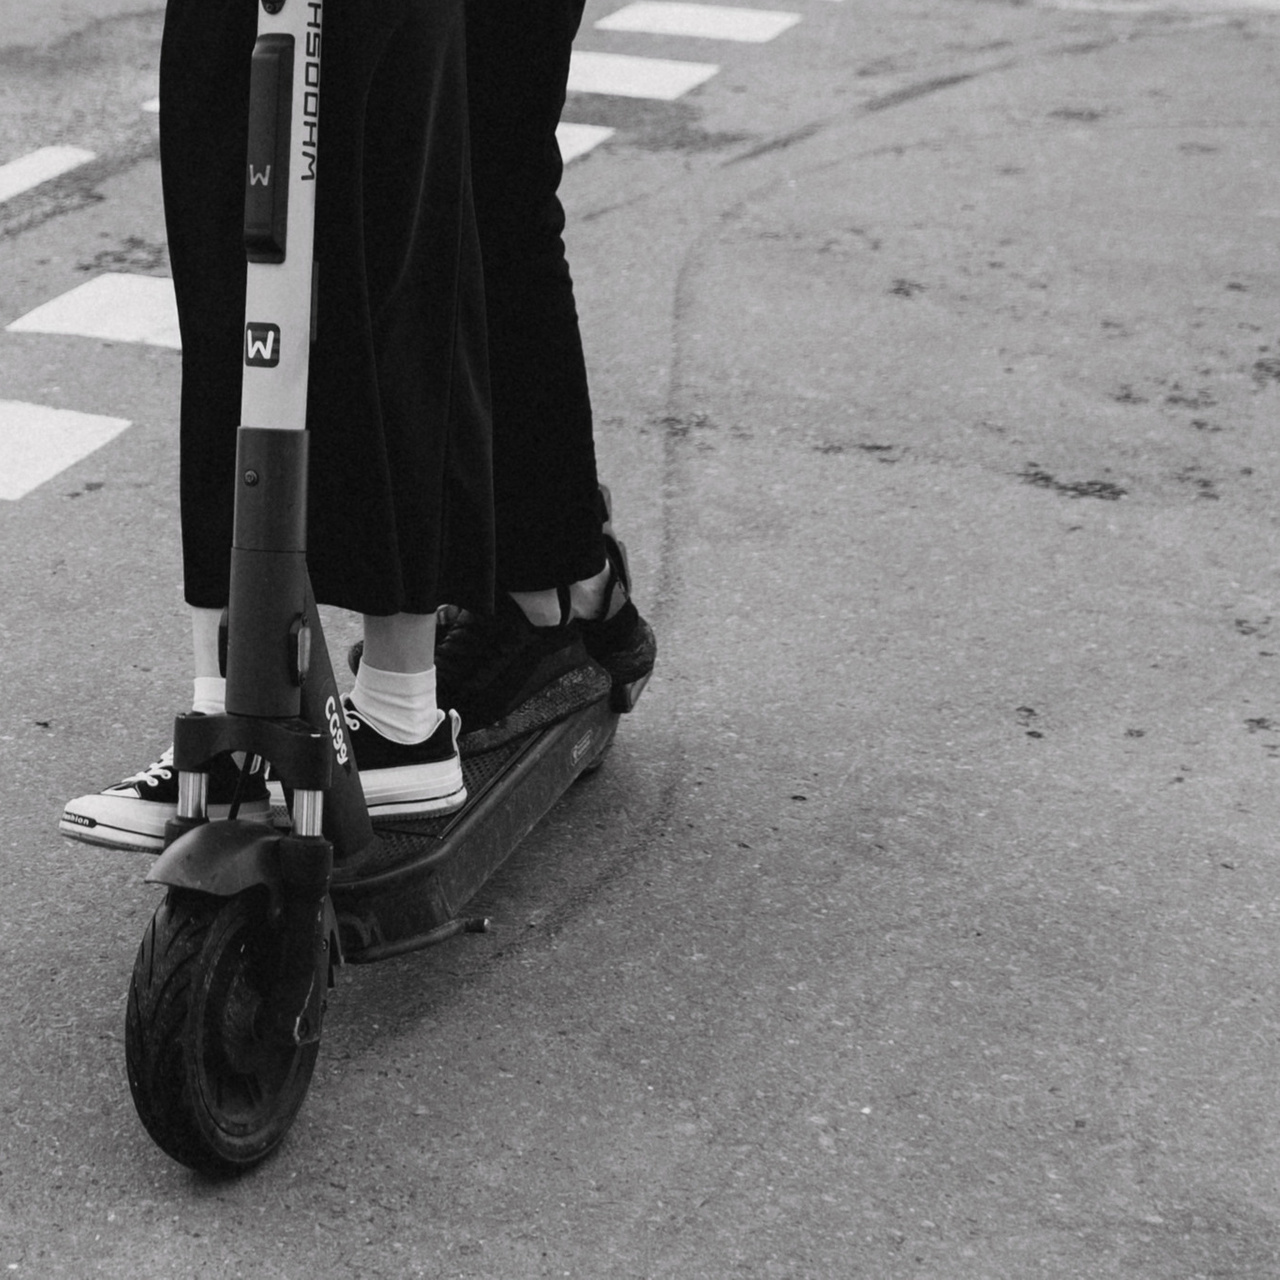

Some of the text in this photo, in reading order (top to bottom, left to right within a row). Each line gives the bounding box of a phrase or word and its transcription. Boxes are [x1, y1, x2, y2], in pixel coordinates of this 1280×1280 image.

[301, 2, 321, 181] WHOOSH
[249, 164, 271, 186] W
[247, 329, 275, 359] W
